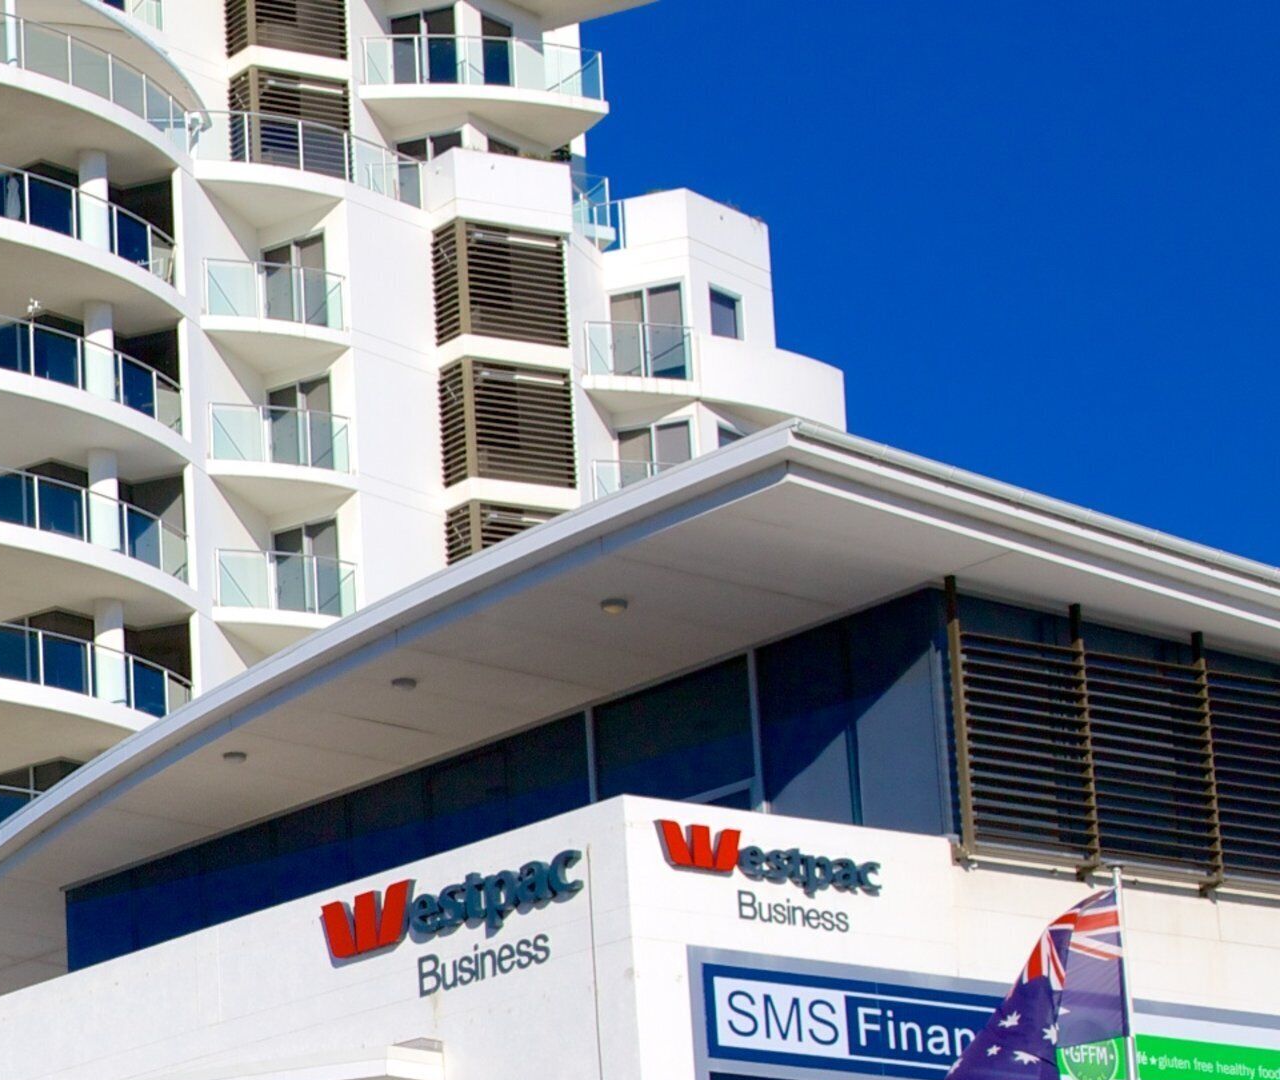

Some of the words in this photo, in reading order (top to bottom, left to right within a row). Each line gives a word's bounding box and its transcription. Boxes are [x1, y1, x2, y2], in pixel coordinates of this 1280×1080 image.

[652, 818, 882, 899] Westpac
[321, 849, 585, 966] Westpac
[737, 889, 850, 933] Business
[417, 933, 551, 998] Business
[726, 989, 840, 1046] SMS
[857, 1006, 978, 1057] Finan
[1158, 1055, 1191, 1071] gluten
[1194, 1056, 1214, 1073] free
[1216, 1061, 1256, 1080] healthy
